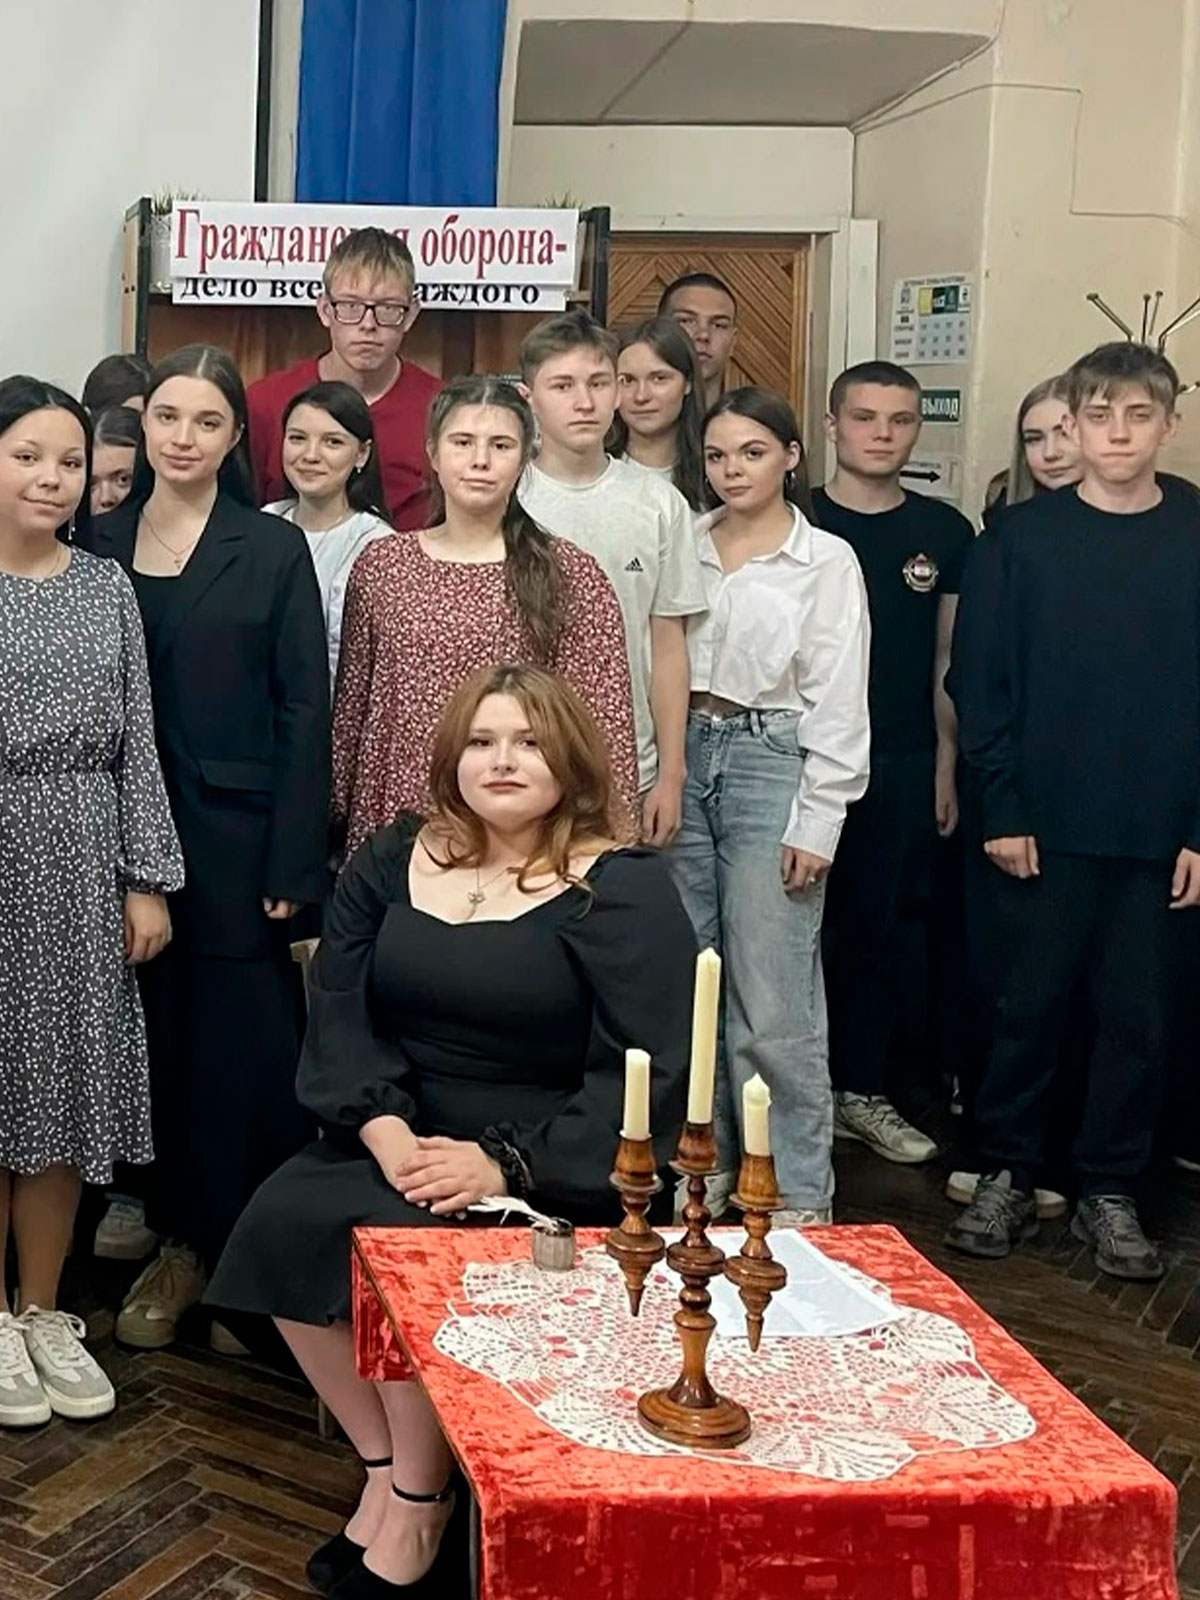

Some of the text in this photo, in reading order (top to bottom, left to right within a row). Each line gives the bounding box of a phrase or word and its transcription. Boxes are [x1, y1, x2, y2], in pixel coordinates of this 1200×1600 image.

[175, 208, 567, 279] Гражданс оборона-
[180, 277, 541, 306] дело все аждого
[921, 397, 959, 419] ВЫХОД
